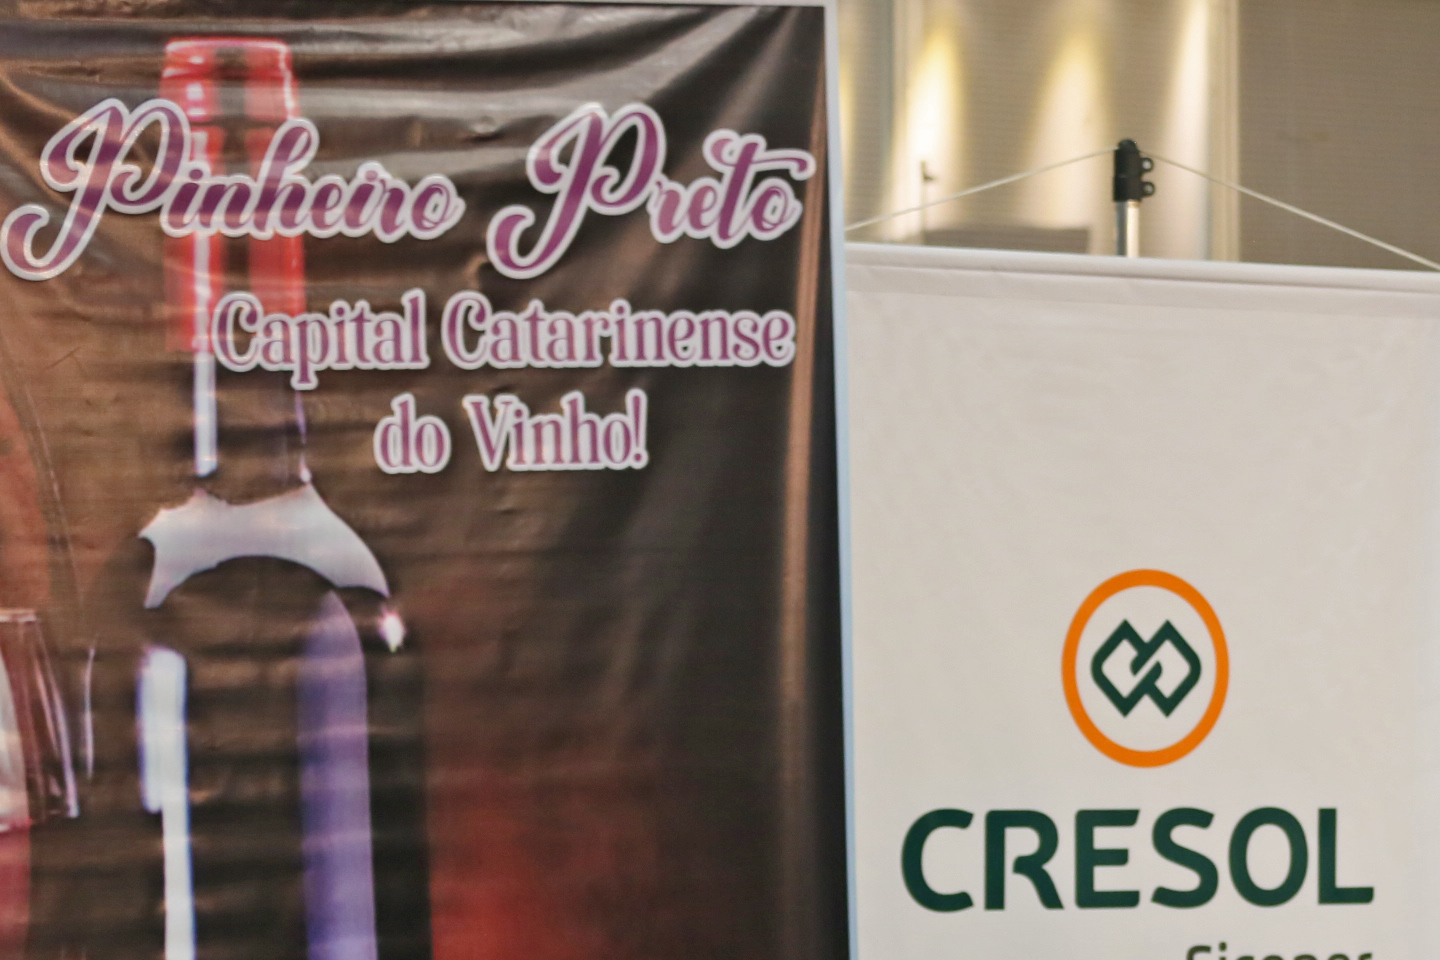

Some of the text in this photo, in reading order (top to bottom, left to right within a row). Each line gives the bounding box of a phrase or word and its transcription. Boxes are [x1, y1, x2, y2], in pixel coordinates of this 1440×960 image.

[0, 97, 817, 281] Pinheiro Preto
[210, 287, 798, 389] Capital Catarinense
[374, 387, 649, 475] do Vinho!
[901, 807, 1375, 913] CRESOL
